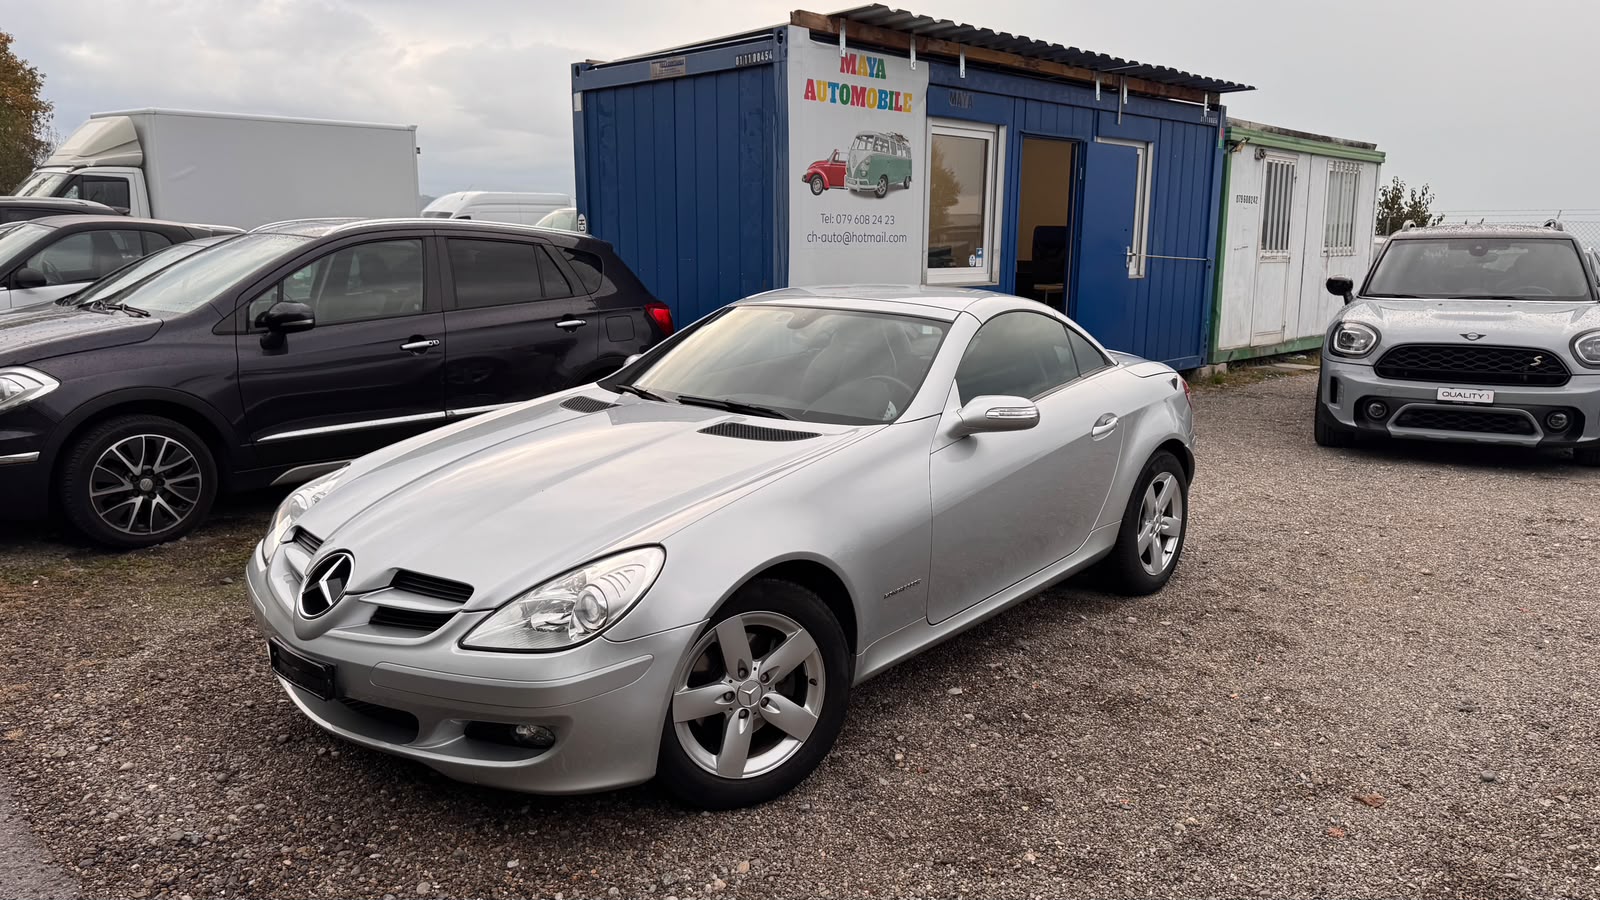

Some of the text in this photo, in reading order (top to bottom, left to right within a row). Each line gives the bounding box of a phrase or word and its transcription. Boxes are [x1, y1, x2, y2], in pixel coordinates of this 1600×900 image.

[840, 52, 887, 80] MAYA
[803, 78, 913, 113] AUTOMOBILE
[820, 213, 895, 225] Tel: 079 608 24 23
[807, 230, 907, 245] ch-auto@hotmail.com
[1441, 391, 1485, 400] QUALITY
